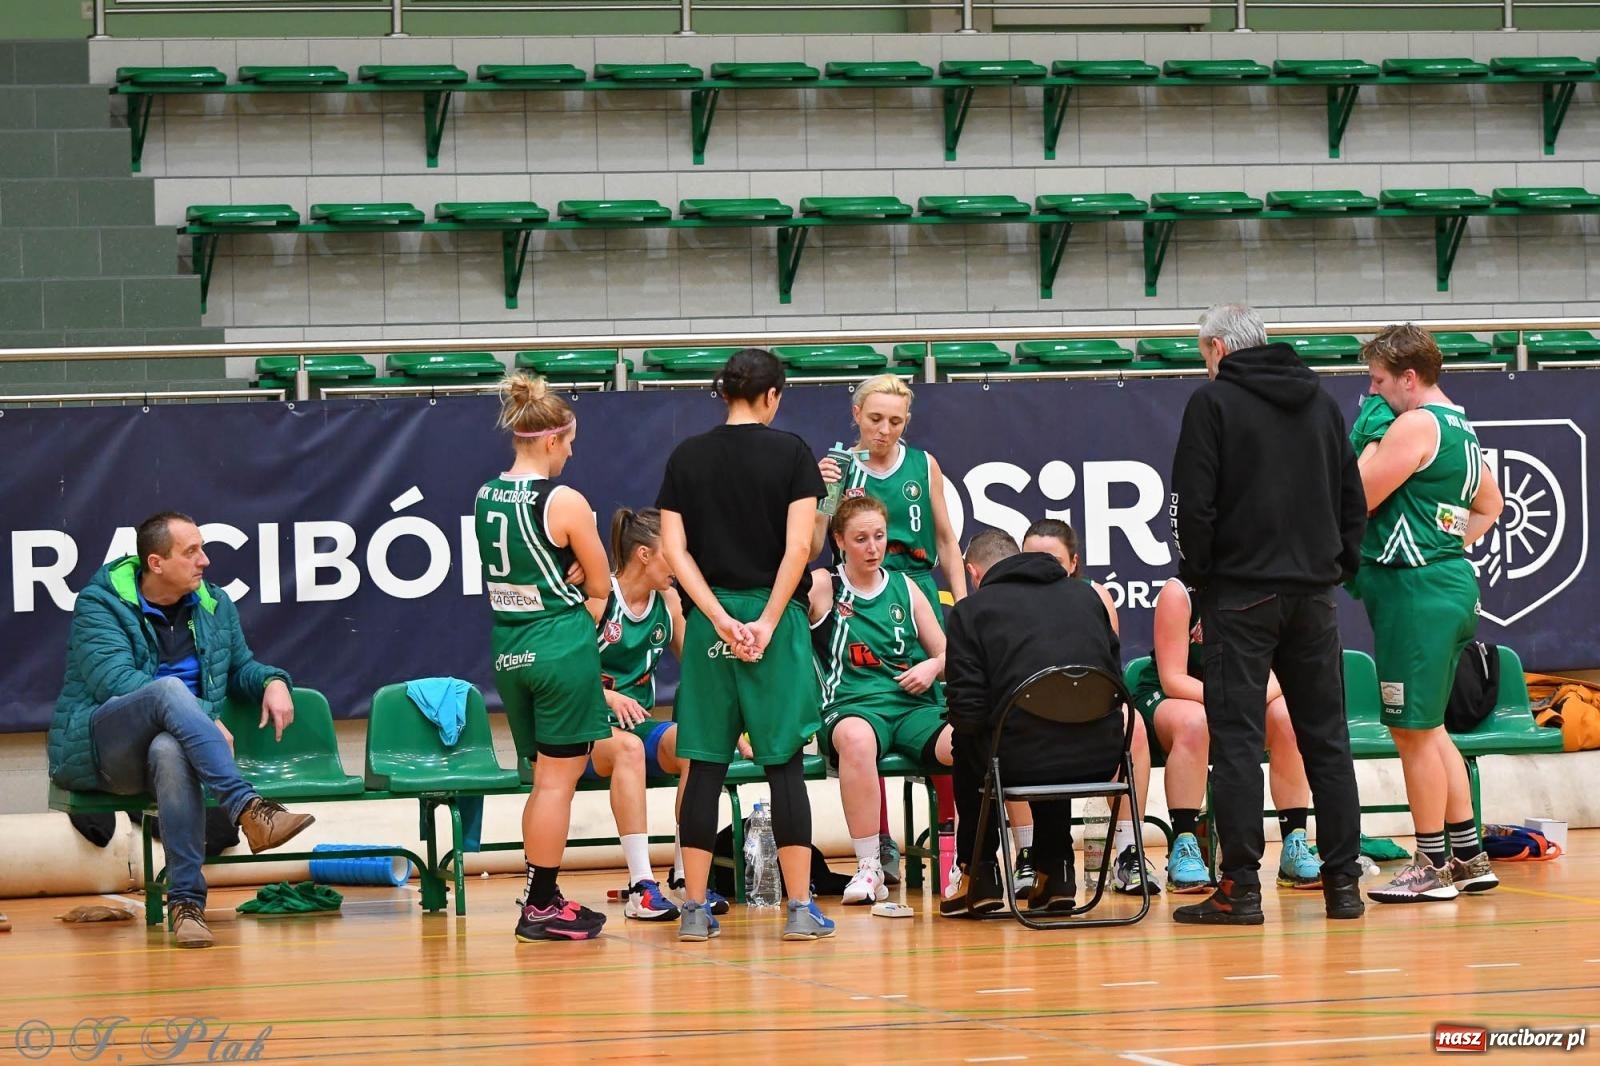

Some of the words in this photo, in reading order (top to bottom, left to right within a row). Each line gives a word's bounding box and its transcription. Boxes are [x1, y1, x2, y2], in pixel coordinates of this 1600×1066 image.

[1460, 439, 1482, 503] 10
[909, 504, 921, 531] 8
[941, 459, 1172, 566] SiR
[486, 510, 511, 577] 3
[503, 649, 537, 668] Clavis
[893, 627, 905, 655] 5
